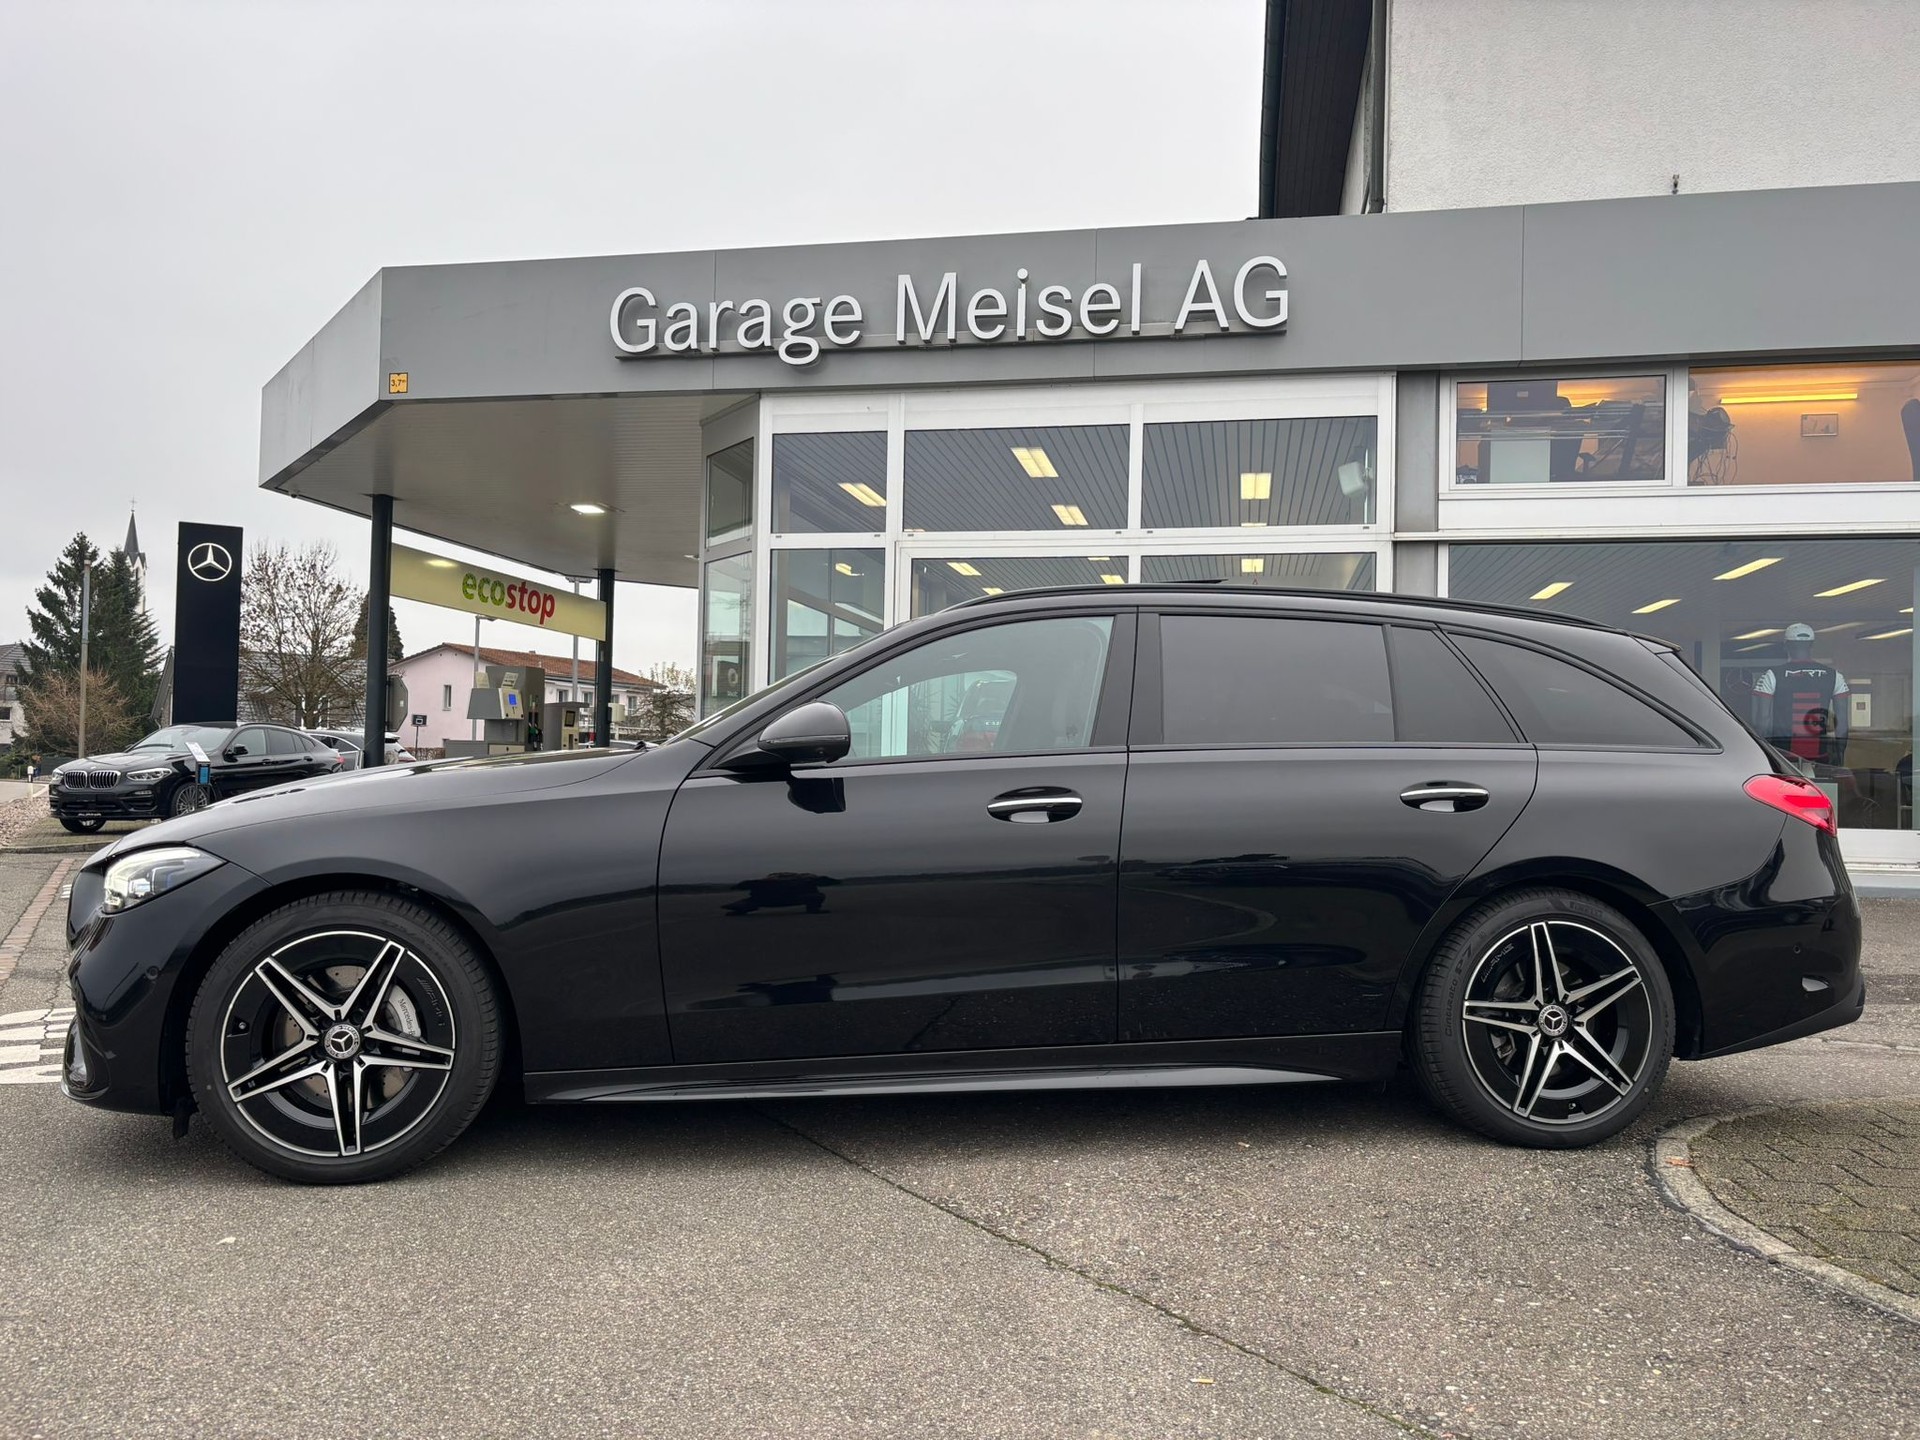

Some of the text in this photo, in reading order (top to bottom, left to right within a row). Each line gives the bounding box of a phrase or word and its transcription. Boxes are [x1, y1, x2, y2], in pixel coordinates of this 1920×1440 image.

[609, 255, 1289, 366] Garage Meisel AG
[462, 573, 556, 625] ecostop
